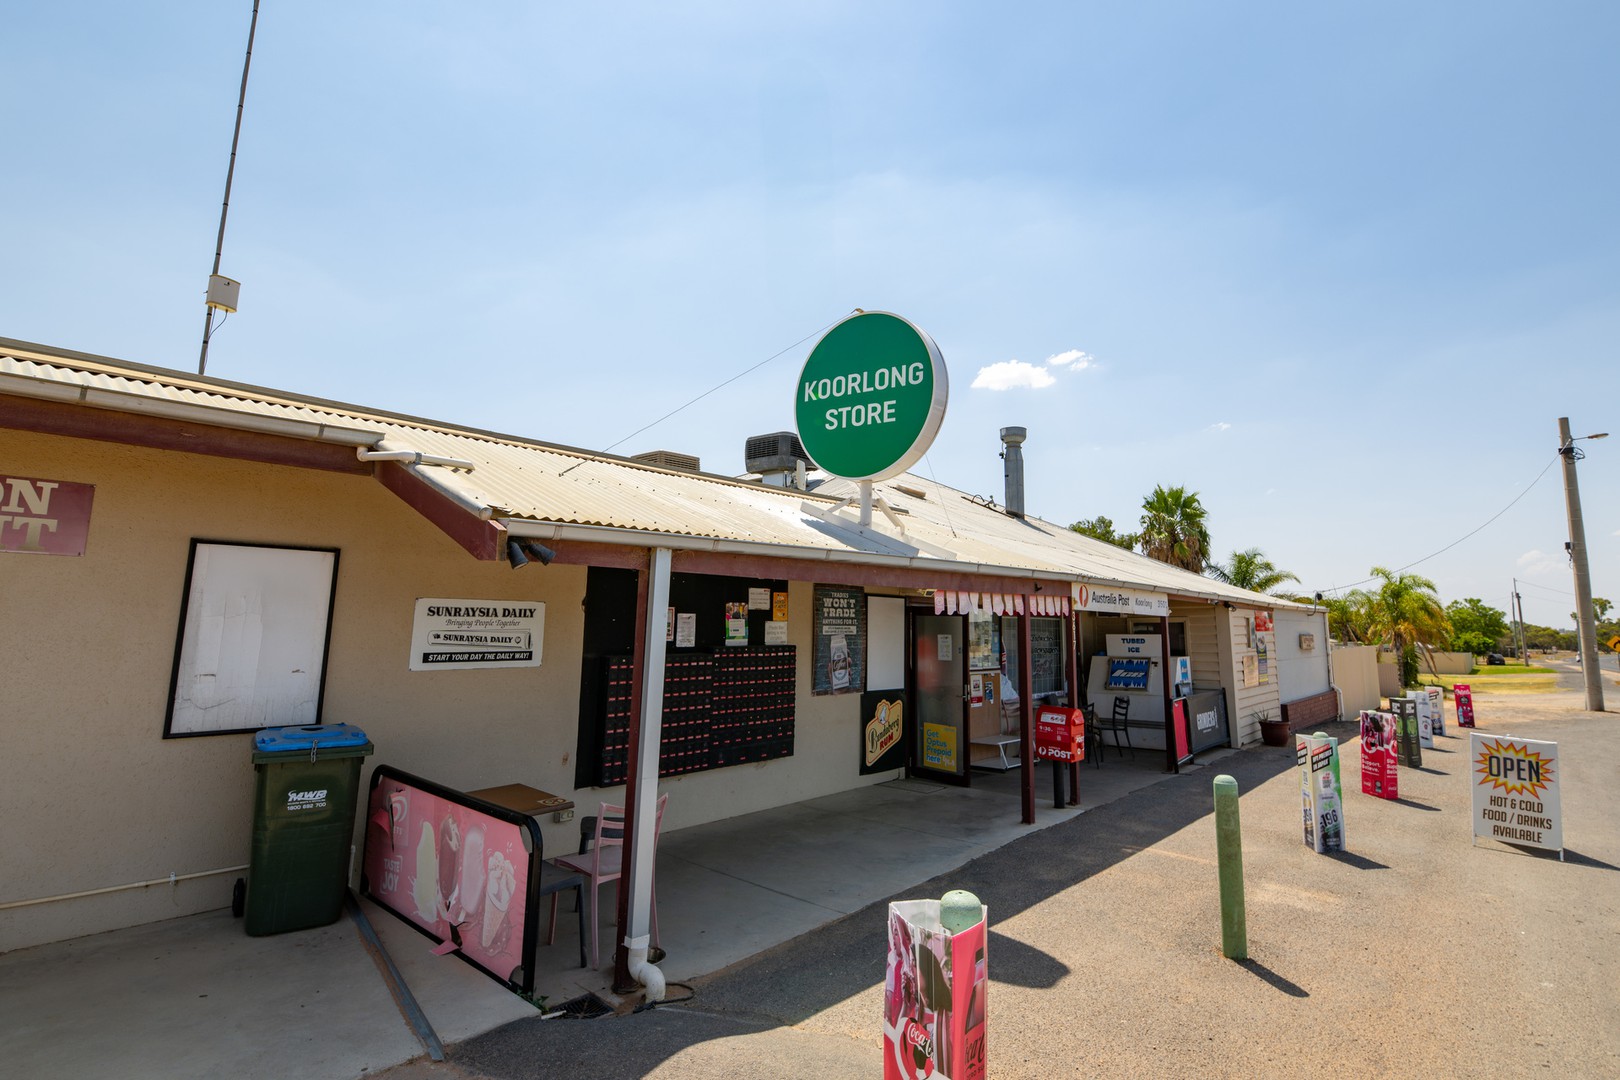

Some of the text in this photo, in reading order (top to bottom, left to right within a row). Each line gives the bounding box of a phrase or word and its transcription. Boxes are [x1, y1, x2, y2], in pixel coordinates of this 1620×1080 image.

[804, 362, 924, 402] KOORLONG
[825, 400, 896, 430] STORE
[823, 598, 856, 608] WON'T
[1092, 591, 1117, 604] Australia
[1118, 594, 1130, 606] Post
[427, 606, 536, 618] SUNRAYSIA DAILY
[823, 608, 856, 618] TRADE
[445, 619, 521, 629] Bringing People Together
[443, 634, 513, 644] SUNRAYSIA DAILY
[428, 654, 450, 662] START
[451, 653, 469, 661] YOUR
[496, 652, 513, 660] DAILY
[927, 729, 939, 738] Get
[880, 732, 894, 751] RUM
[926, 738, 947, 748] Optus
[926, 746, 952, 756] Prepaid
[1048, 749, 1072, 759] POST
[926, 754, 941, 764] here
[1488, 755, 1540, 782] OPEN
[1489, 795, 1543, 814] HOT & COLD
[1482, 808, 1552, 830] FOOD / DRINKS
[1493, 824, 1543, 843] AVAILABLE
[384, 858, 400, 872] TASTE
[382, 873, 399, 891] JOY
